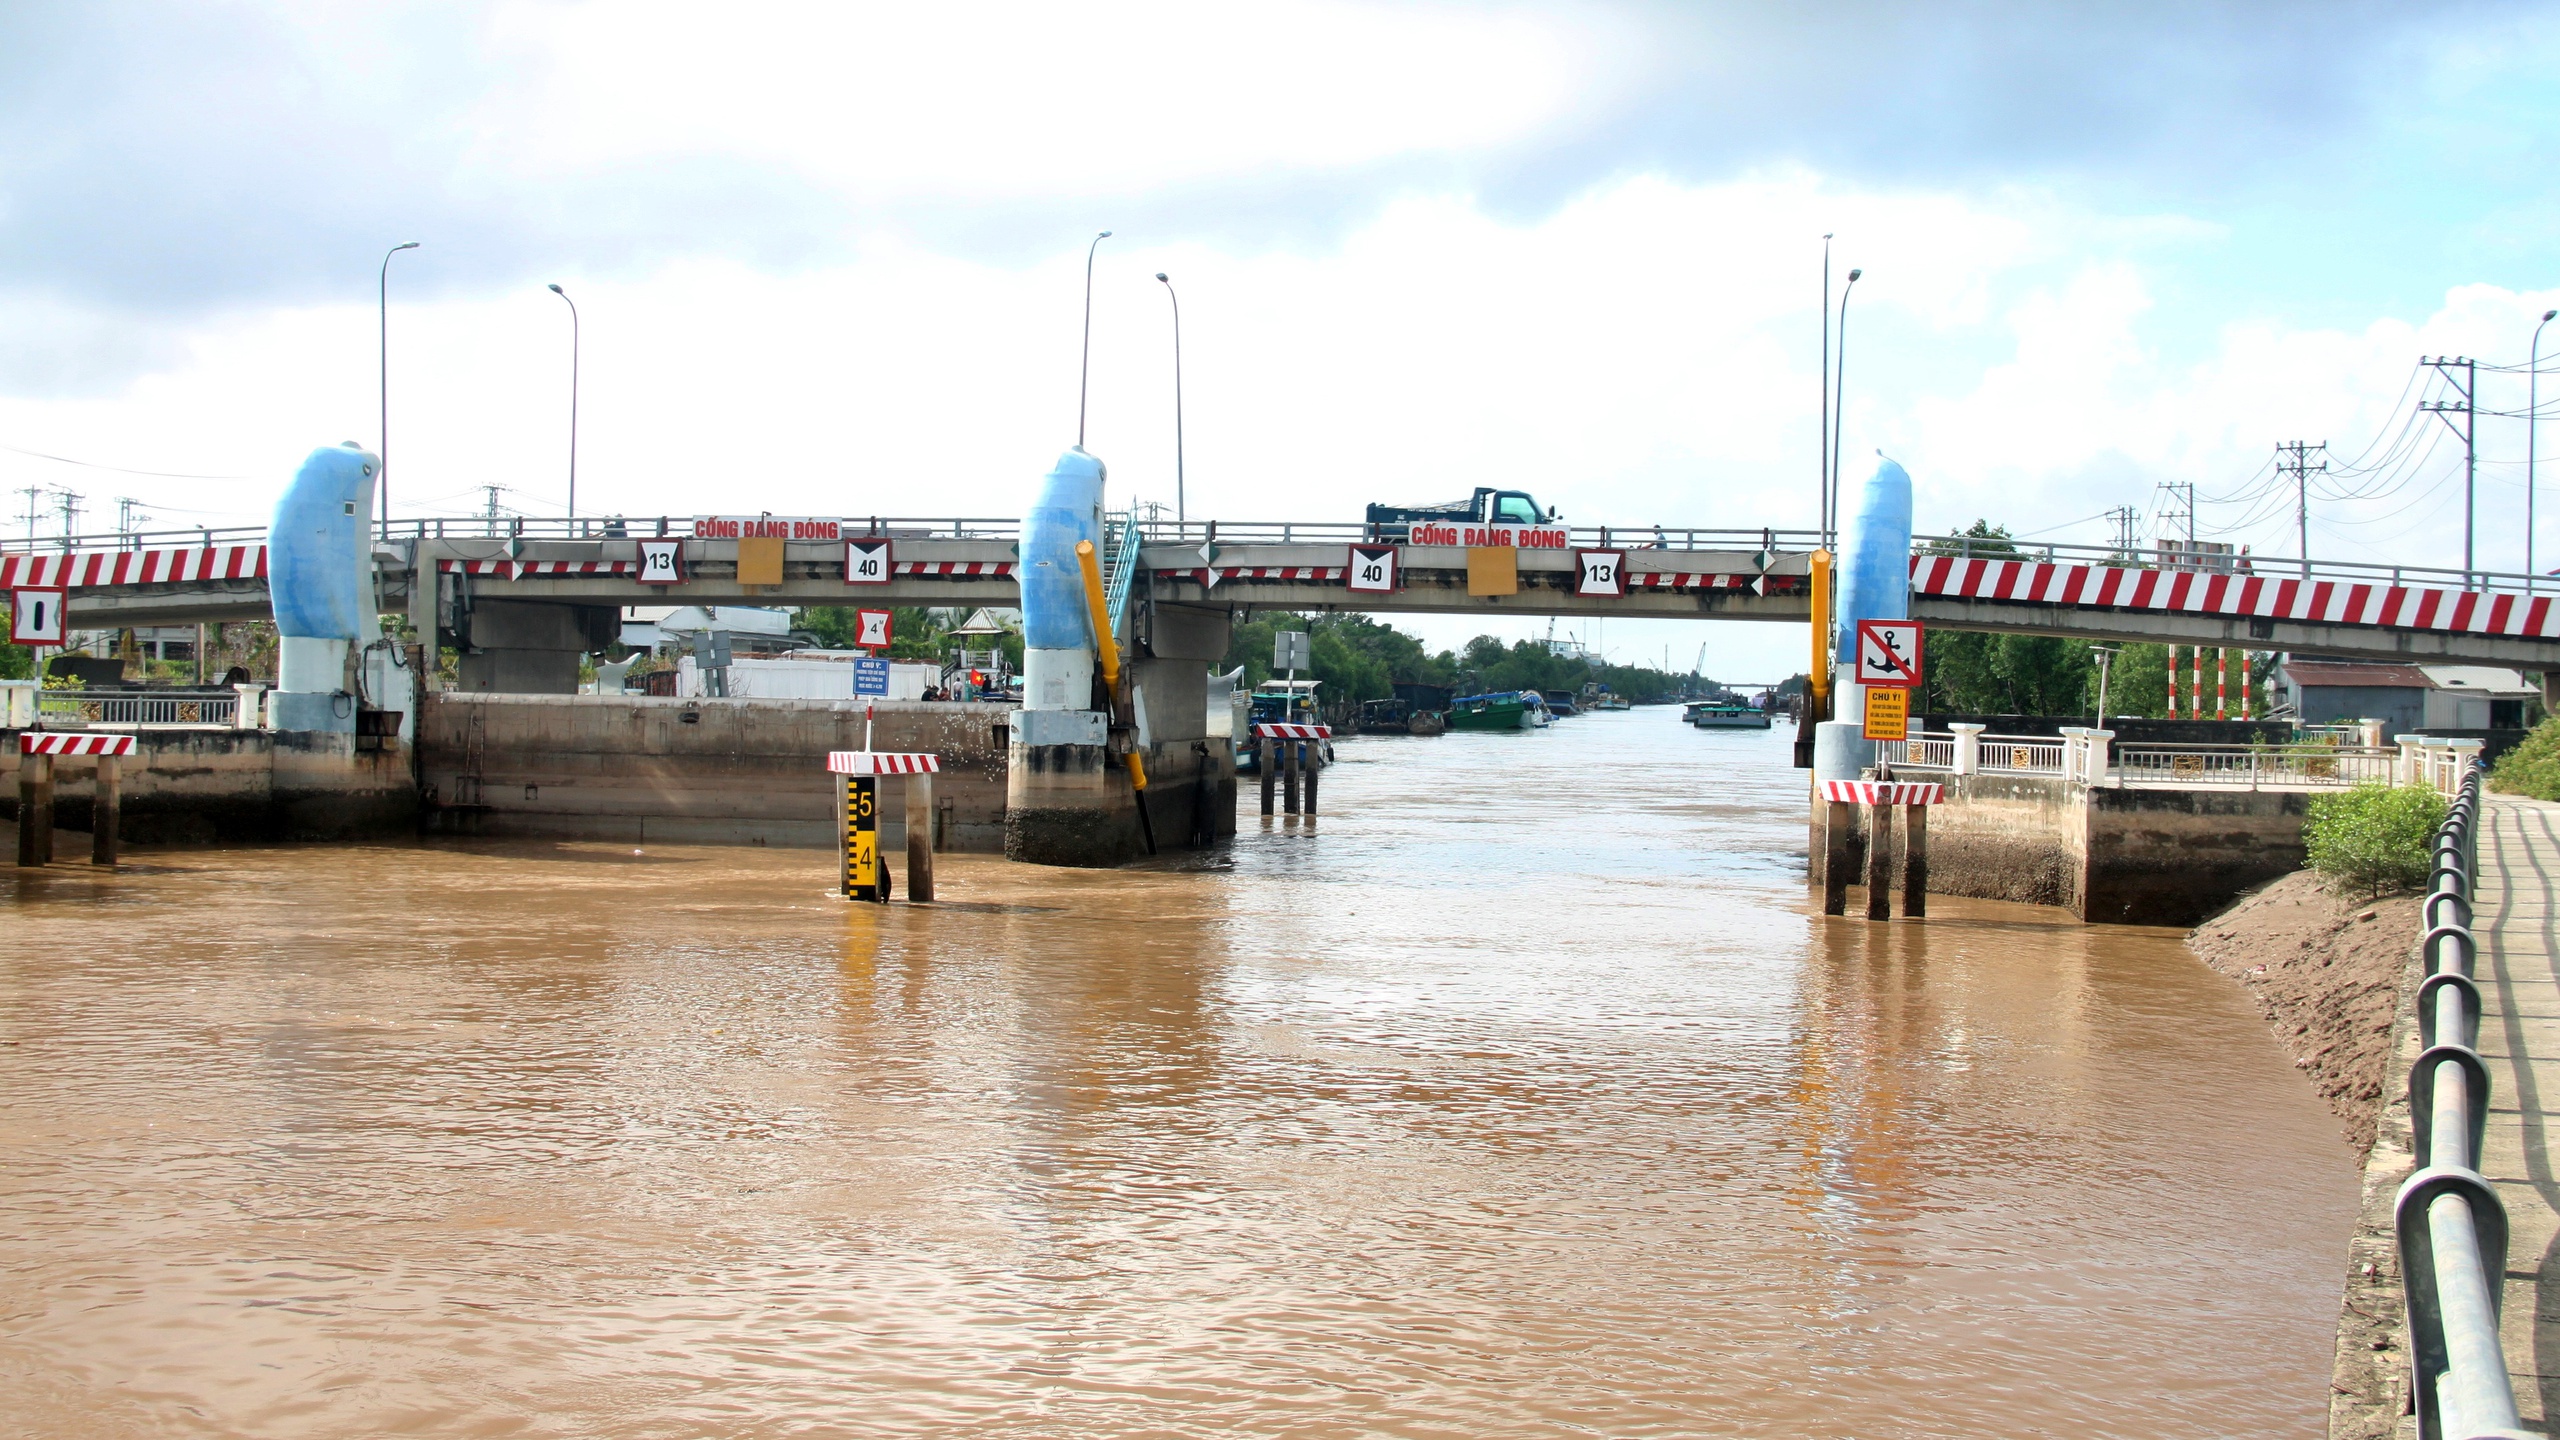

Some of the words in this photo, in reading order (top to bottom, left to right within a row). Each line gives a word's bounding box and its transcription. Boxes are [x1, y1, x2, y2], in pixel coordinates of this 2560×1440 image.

[695, 516, 738, 538] CỐNG
[743, 521, 789, 539] ĐANG
[794, 518, 838, 540] ĐÓNG
[1411, 523, 1458, 546] CỐNG
[1464, 528, 1512, 547] ĐANG
[1518, 526, 1566, 549] ĐÓNG
[649, 552, 670, 569] 13
[1589, 564, 1611, 582] 13
[1872, 691, 1890, 701] CHÚ
[859, 791, 872, 816] 5
[859, 846, 872, 870] 4
